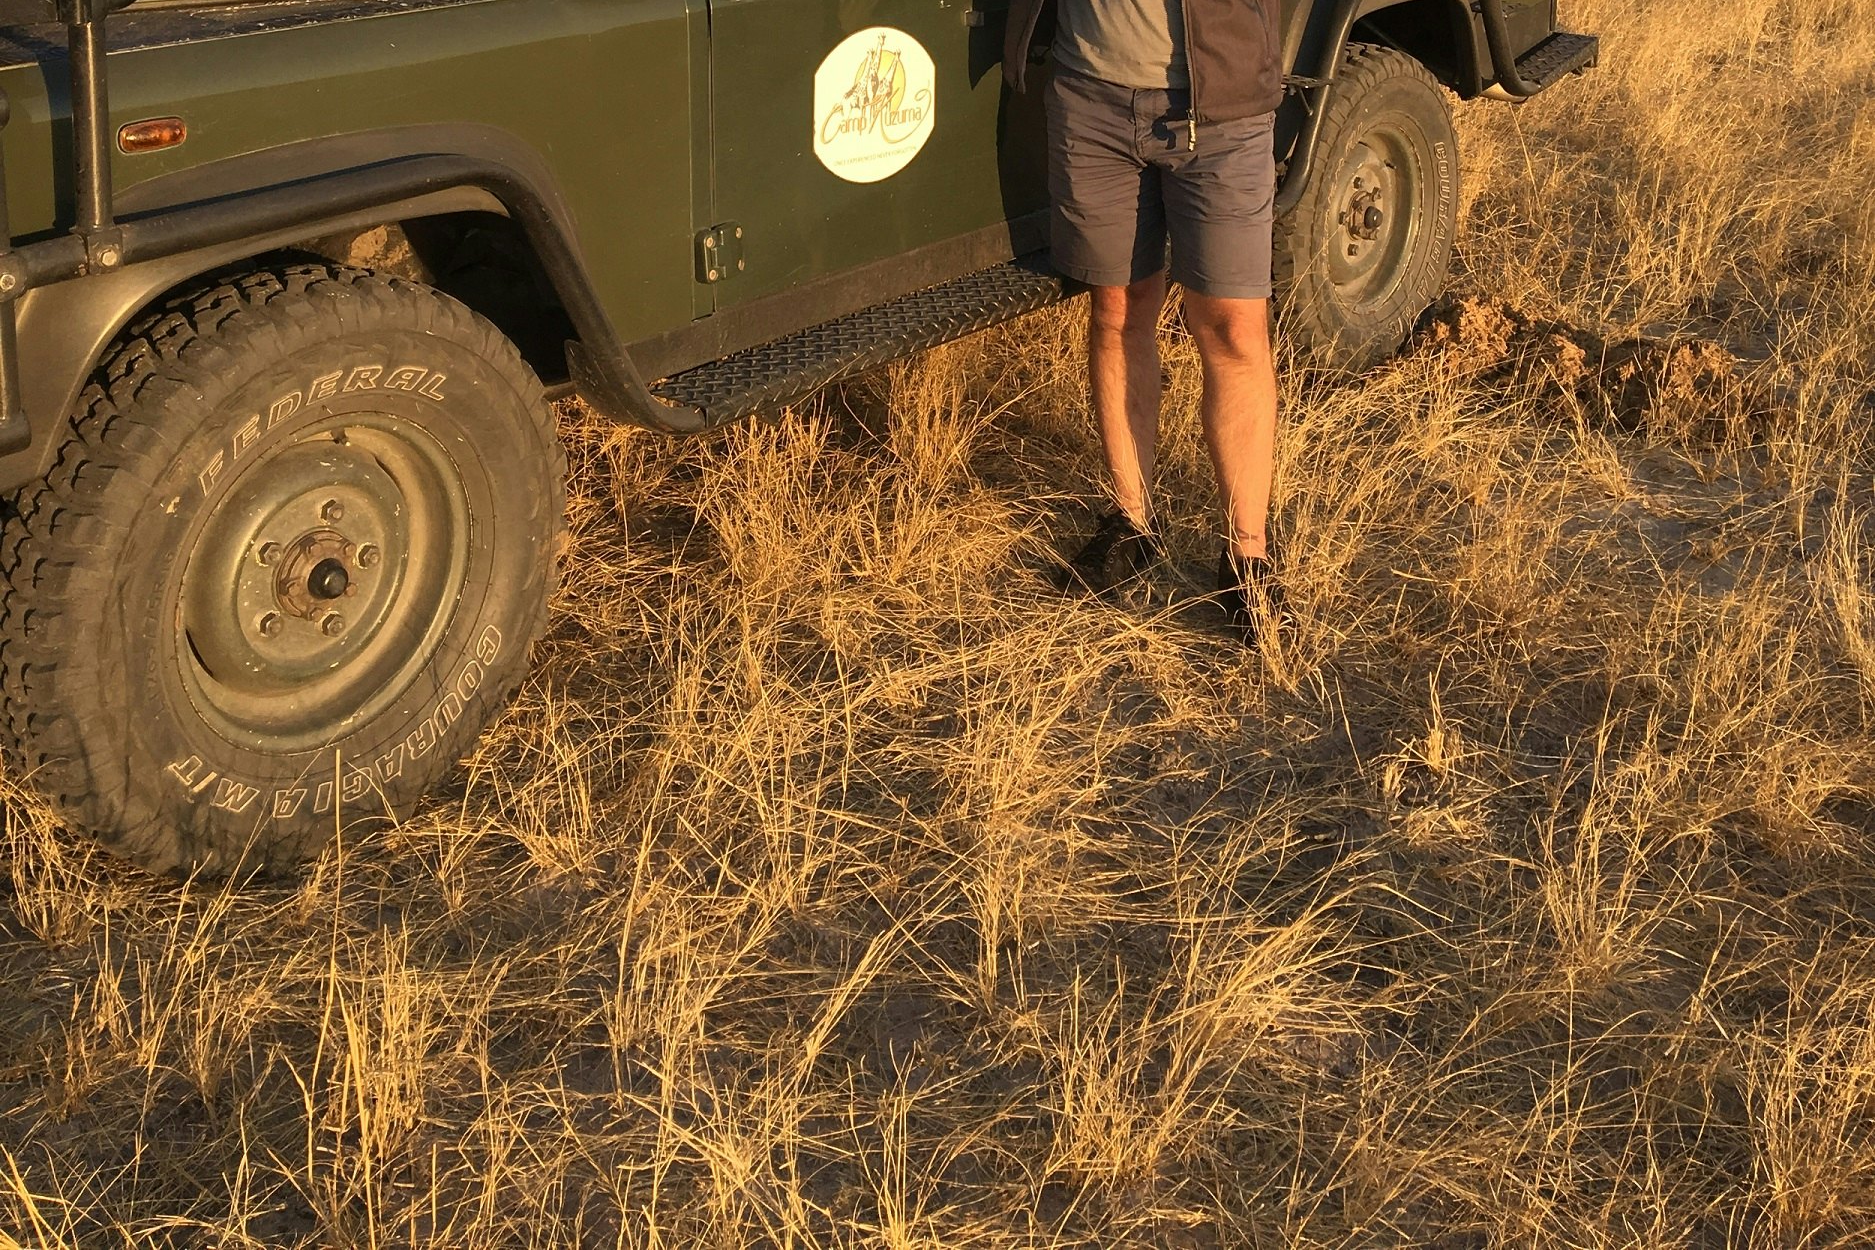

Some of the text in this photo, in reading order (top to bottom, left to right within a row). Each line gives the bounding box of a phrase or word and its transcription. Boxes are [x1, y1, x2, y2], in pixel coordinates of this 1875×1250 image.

[820, 103, 867, 145] Camp
[198, 365, 447, 497] FEDERAL
[168, 624, 502, 819] COURAGIA M/T
